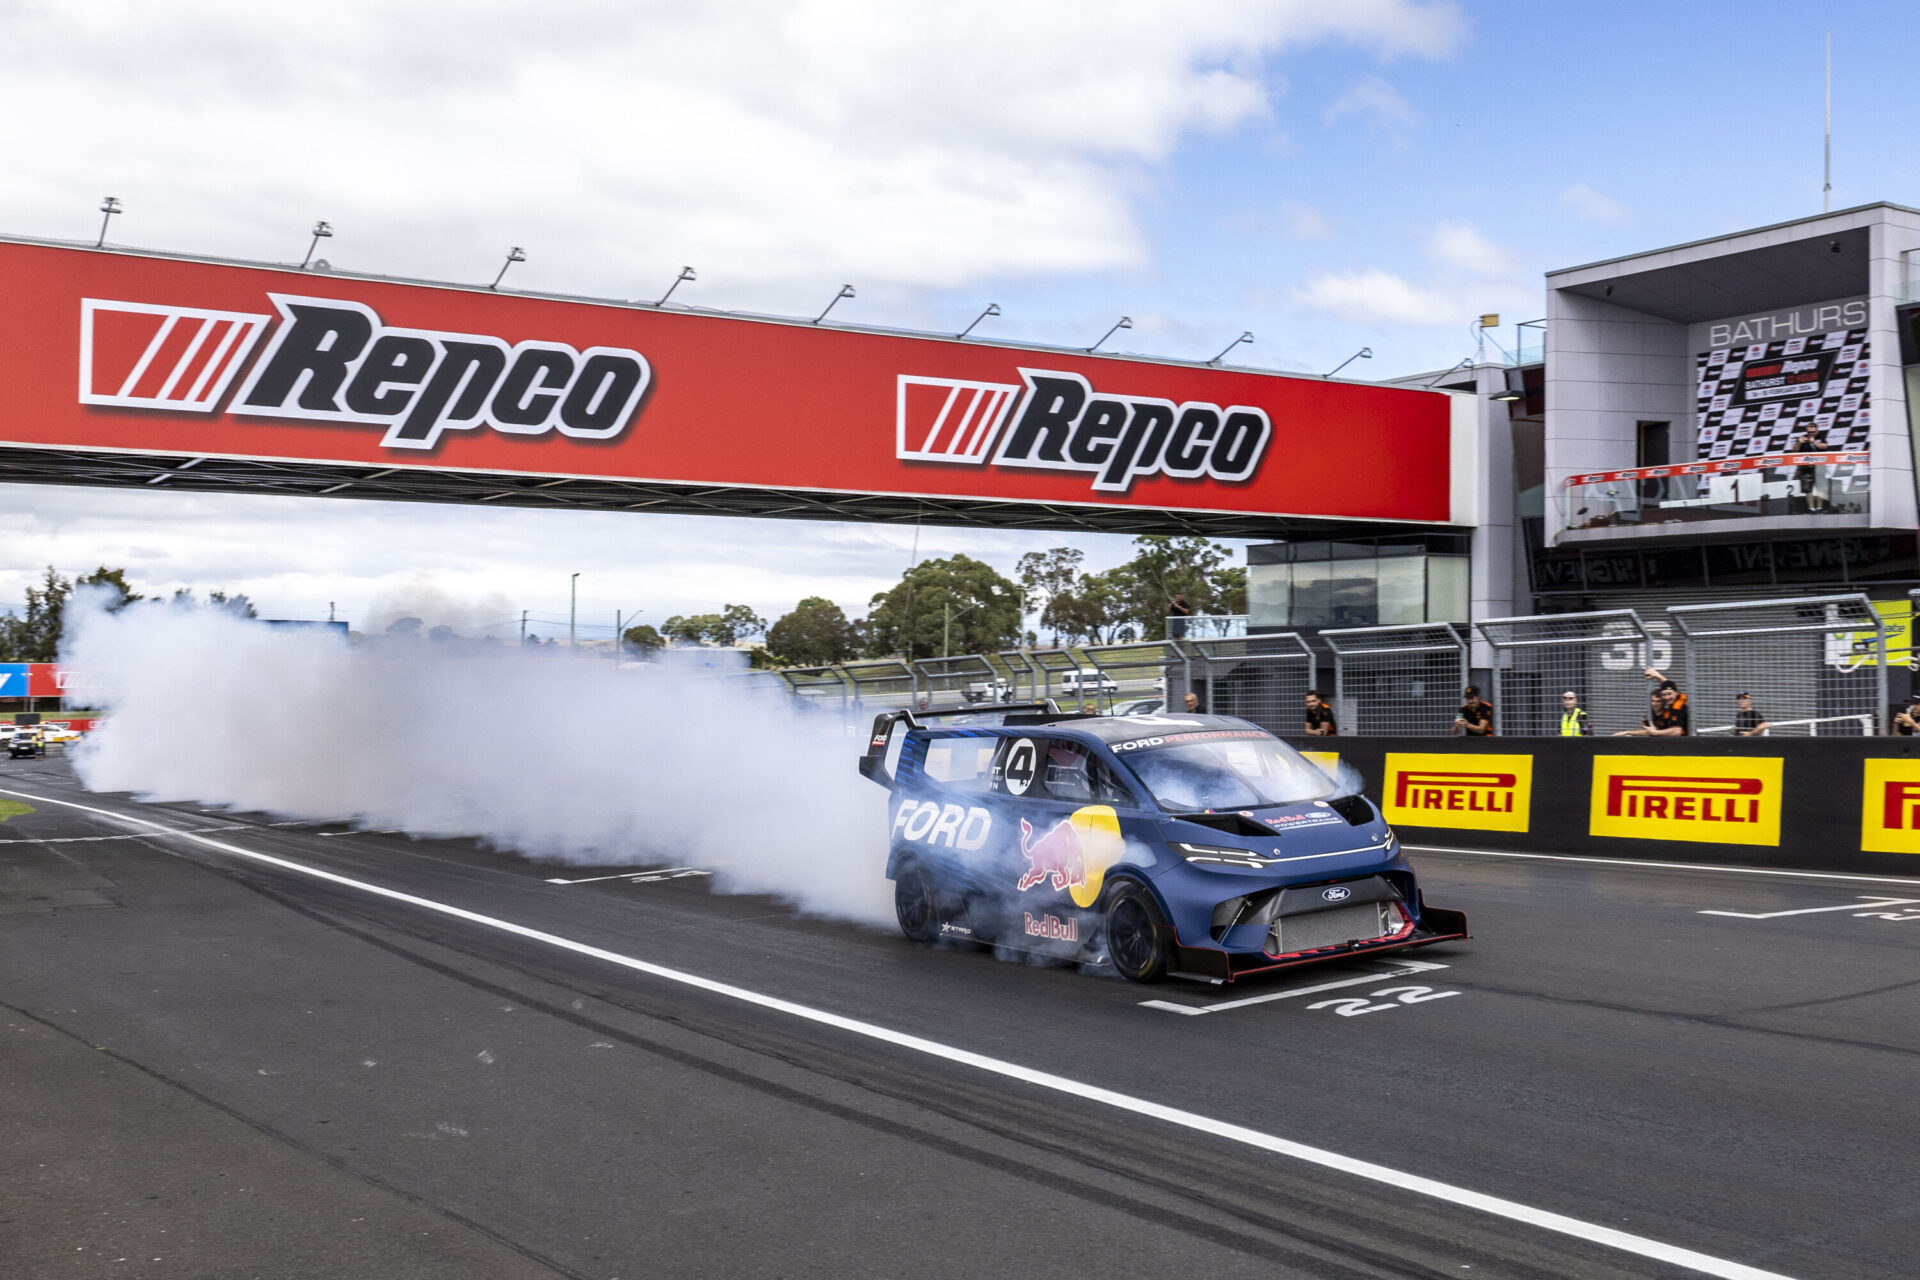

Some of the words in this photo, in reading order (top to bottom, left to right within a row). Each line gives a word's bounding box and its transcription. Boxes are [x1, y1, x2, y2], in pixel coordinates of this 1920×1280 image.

[1710, 301, 1868, 347] BATHURS
[228, 292, 651, 450] Repco
[1745, 377, 1786, 389] BATHURST
[991, 367, 1271, 491] Repco
[1730, 479, 1740, 504] 1
[1786, 484, 1795, 497] 2
[1601, 621, 1672, 670] 36
[1111, 738, 1164, 753] FORD
[1165, 730, 1270, 744] PERFORMANCE
[1007, 746, 1033, 779] 4
[1395, 771, 1517, 812] PIRELLI
[1607, 775, 1763, 823] PIRELLI
[891, 799, 992, 851] FORD
[1274, 817, 1339, 828] POWERTRAINS
[1328, 889, 1345, 899] Ford
[1306, 986, 1462, 1016] 22
